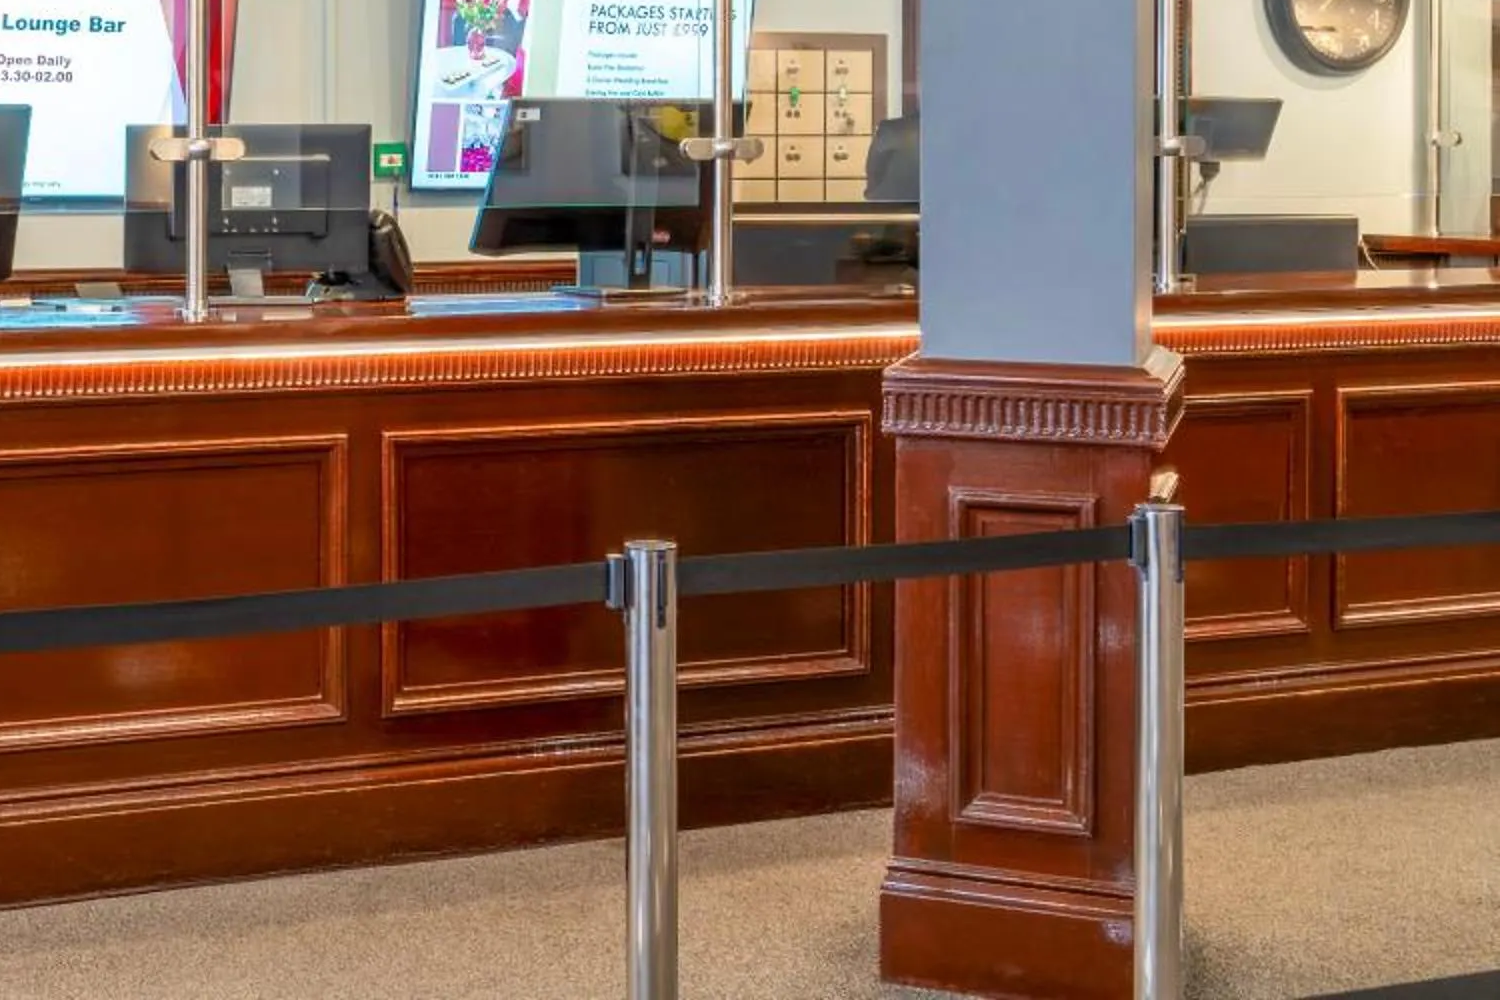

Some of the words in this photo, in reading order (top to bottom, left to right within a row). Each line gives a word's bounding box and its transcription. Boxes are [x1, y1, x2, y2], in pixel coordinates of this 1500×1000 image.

[591, 3, 665, 20] PACKAGES
[2, 13, 81, 36] Lounge
[89, 15, 127, 33] Bar
[589, 21, 631, 35] FROM
[636, 23, 668, 36] JUST
[37, 55, 72, 69] Daily
